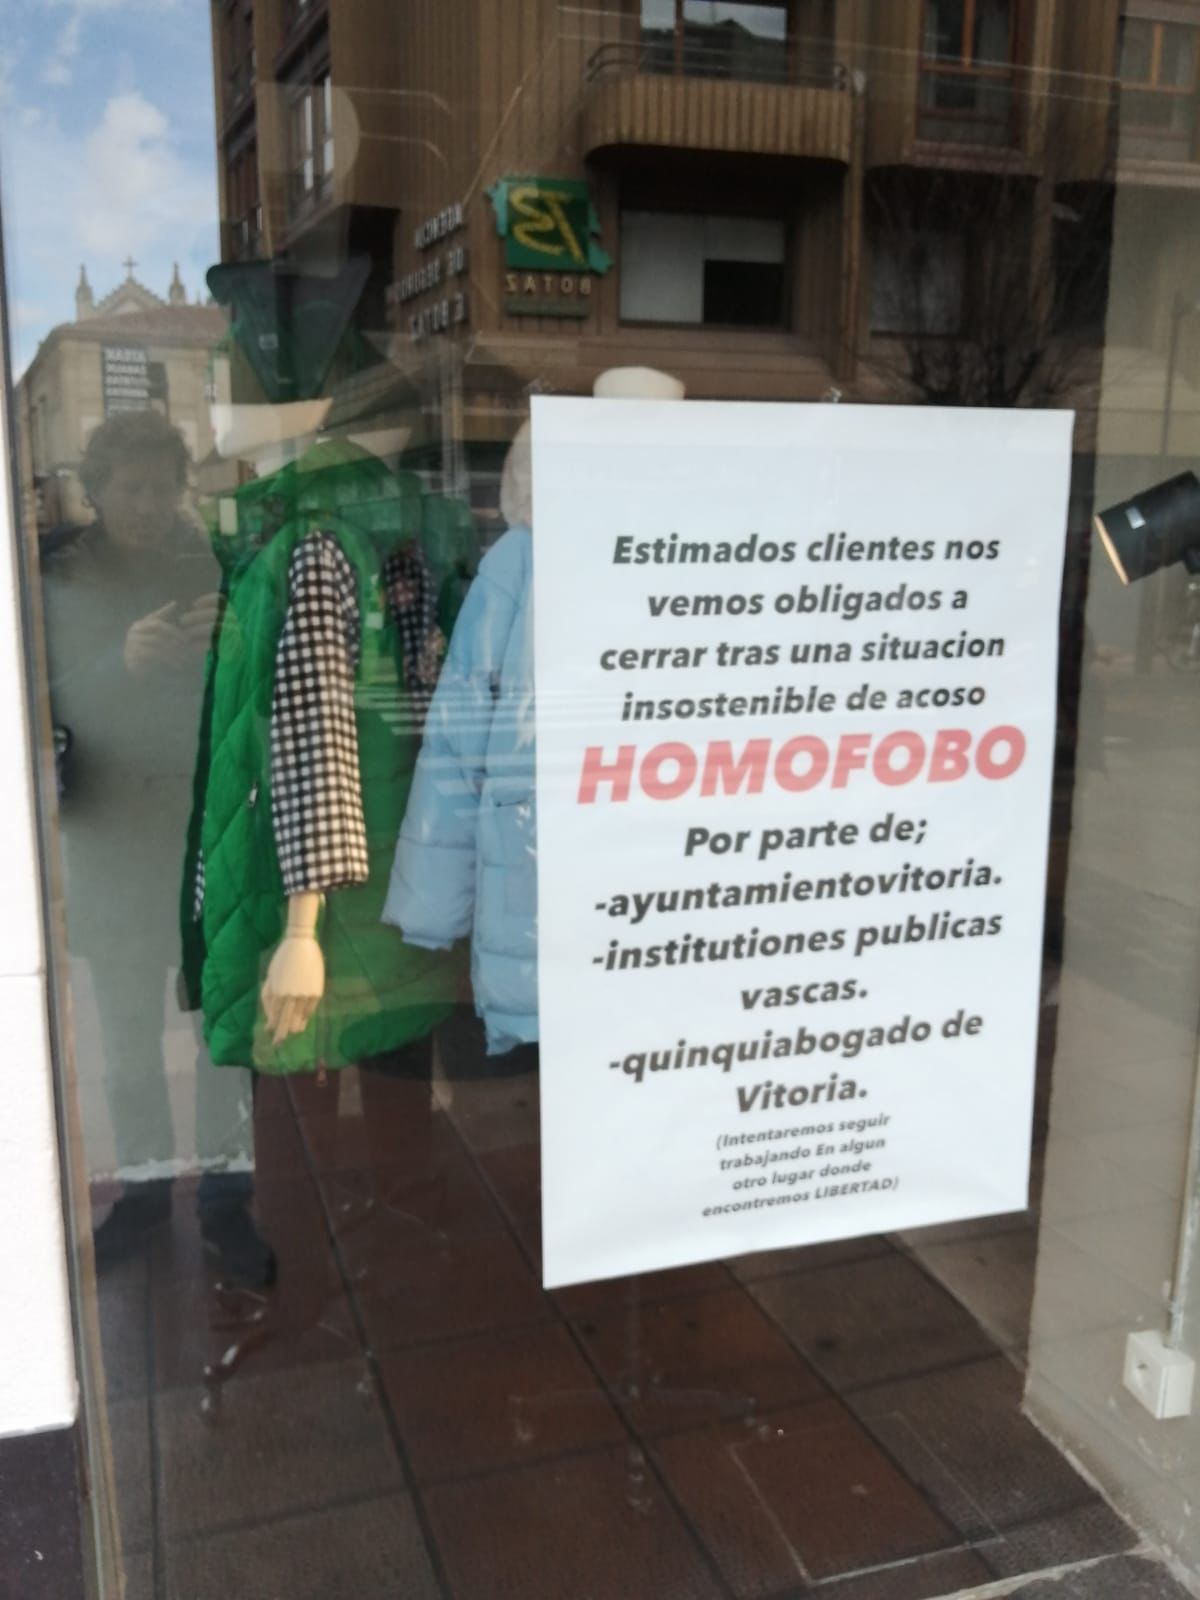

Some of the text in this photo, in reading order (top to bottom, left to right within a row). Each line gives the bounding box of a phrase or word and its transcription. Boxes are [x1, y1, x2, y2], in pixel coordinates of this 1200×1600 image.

[613, 532, 1000, 564] Estimados clientes nos
[648, 584, 968, 620] vemos obligados a
[600, 630, 1004, 670] cerrar tras una situacion
[622, 684, 985, 721] insostenible de acoso
[577, 725, 1026, 804] HOMOFOBO
[685, 813, 927, 860] Por parte de;
[593, 858, 1002, 924] -ayuntamientovitoria.
[591, 911, 1002, 970] -institutiones publicas
[741, 979, 867, 1010] vascas.
[608, 1010, 983, 1083] -quinquiabogado de
[737, 1073, 867, 1112] Vitoria.
[716, 1113, 890, 1151] (Intentaremos seguir
[720, 1139, 885, 1171] trabajando En algun
[732, 1160, 872, 1190] otro lugar donde
[702, 1178, 899, 1217] encontremos LIBERTAD)
